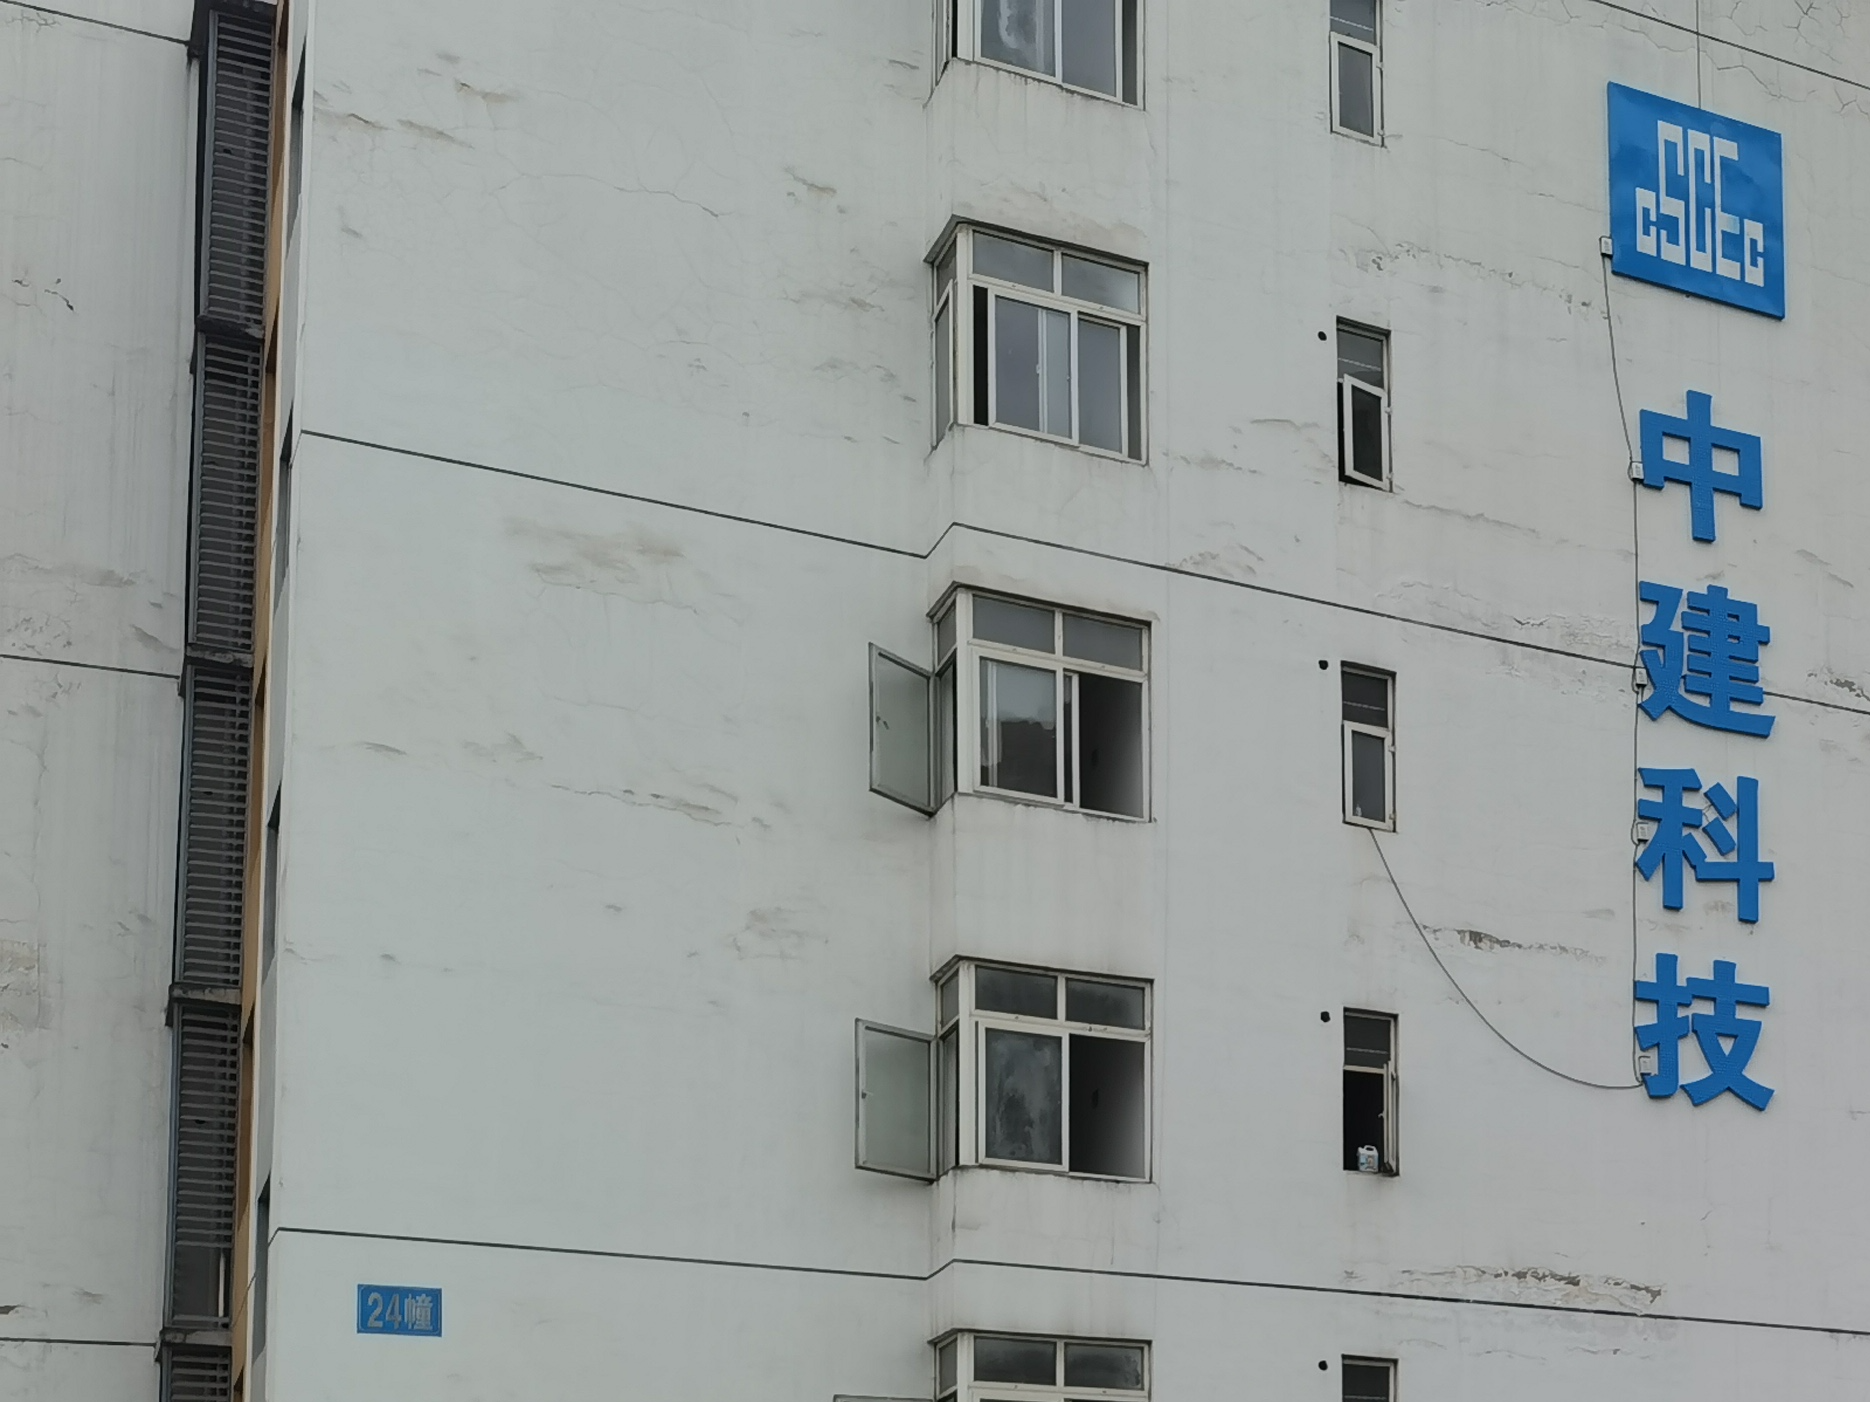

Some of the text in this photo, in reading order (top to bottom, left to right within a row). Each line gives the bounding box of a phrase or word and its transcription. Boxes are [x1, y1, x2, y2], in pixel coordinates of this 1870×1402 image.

[1634, 389, 1777, 1112] 中建科技
[367, 1291, 434, 1331] 24幢
